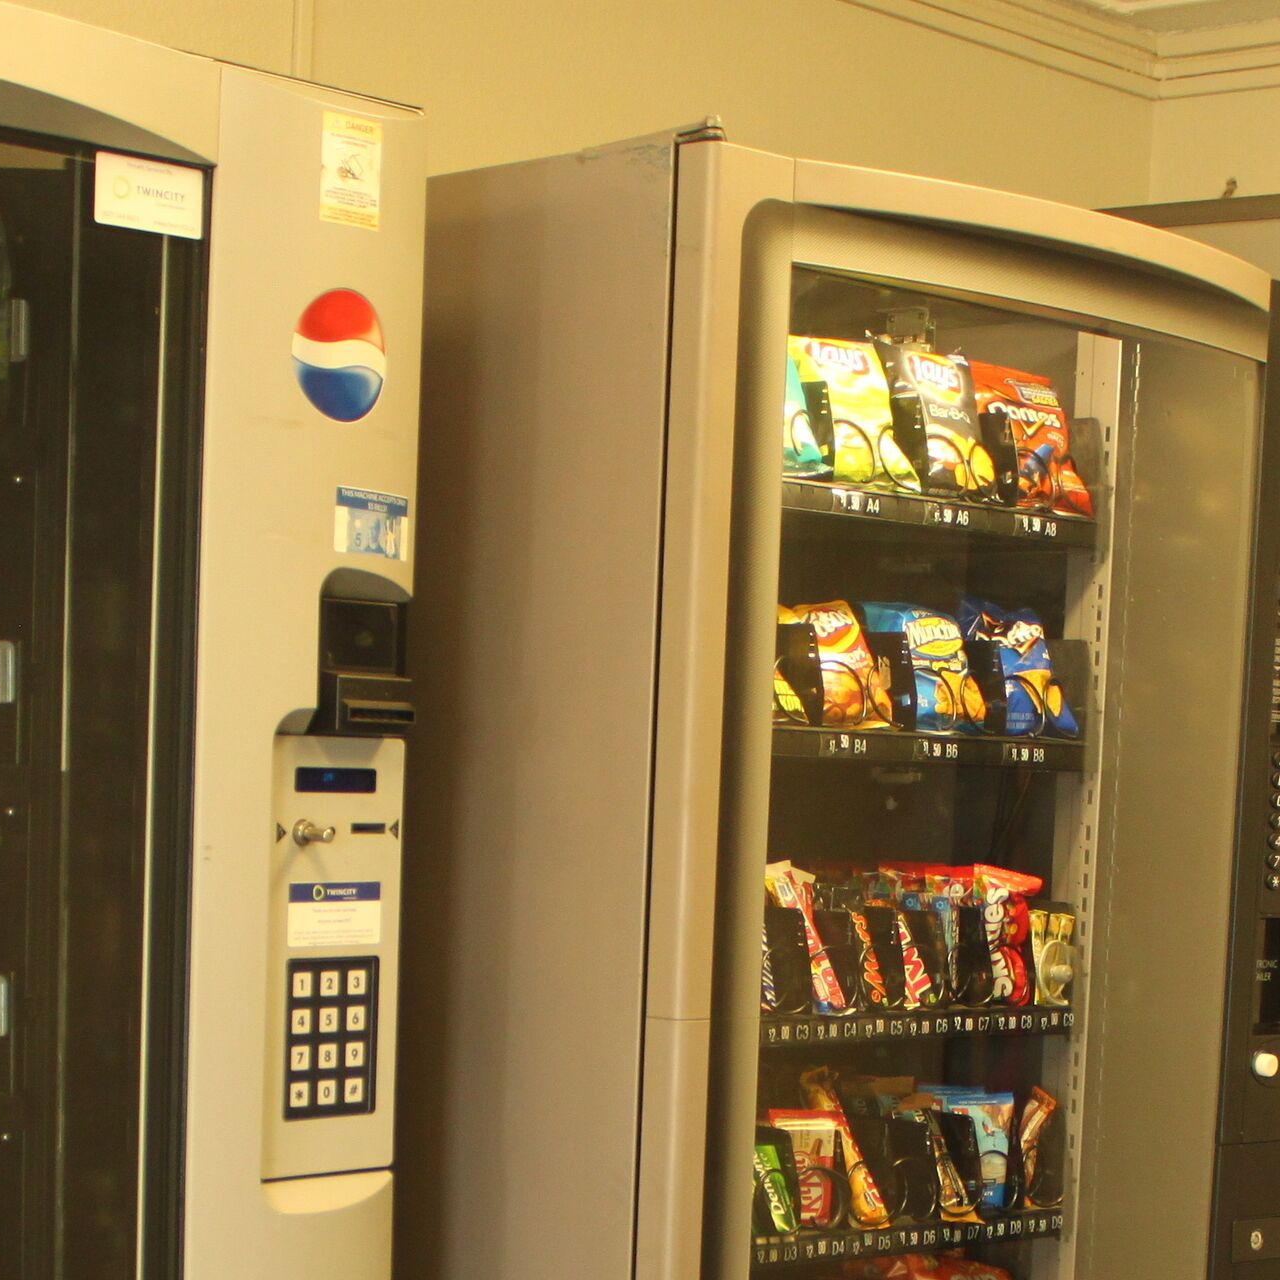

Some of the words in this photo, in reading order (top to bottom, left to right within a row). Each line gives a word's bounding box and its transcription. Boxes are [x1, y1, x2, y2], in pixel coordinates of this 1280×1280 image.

[136, 185, 185, 203] TWINCITY
[866, 498, 880, 514] A4
[956, 509, 969, 526] A6
[1044, 521, 1057, 537] A8
[854, 738, 867, 754] B4
[946, 743, 958, 759] B6
[1033, 748, 1045, 763] B8
[1273, 856, 1280, 868] 7
[298, 979, 304, 991] 1
[326, 978, 333, 990] 2
[353, 976, 360, 989] 3
[297, 1015, 305, 1027] 4
[325, 1014, 332, 1026] 5
[352, 1012, 359, 1025] 6
[935, 1018, 948, 1033] C6
[978, 1017, 990, 1032] C7
[1021, 1015, 1032, 1029] C8
[1063, 1012, 1075, 1027] C9
[796, 1024, 809, 1040] C3
[844, 1022, 857, 1038] C4
[890, 1020, 903, 1036] C5
[296, 1052, 304, 1064] 7
[324, 1050, 331, 1062] 8
[351, 1048, 358, 1061] 9
[349, 1084, 358, 1096] #
[1010, 1219, 1022, 1235] D8
[1052, 1215, 1064, 1230] D9
[923, 1229, 936, 1245] D6
[967, 1225, 980, 1240] D7
[832, 1240, 845, 1256] D4
[878, 1235, 891, 1250] D5
[784, 1246, 797, 1261] D3
